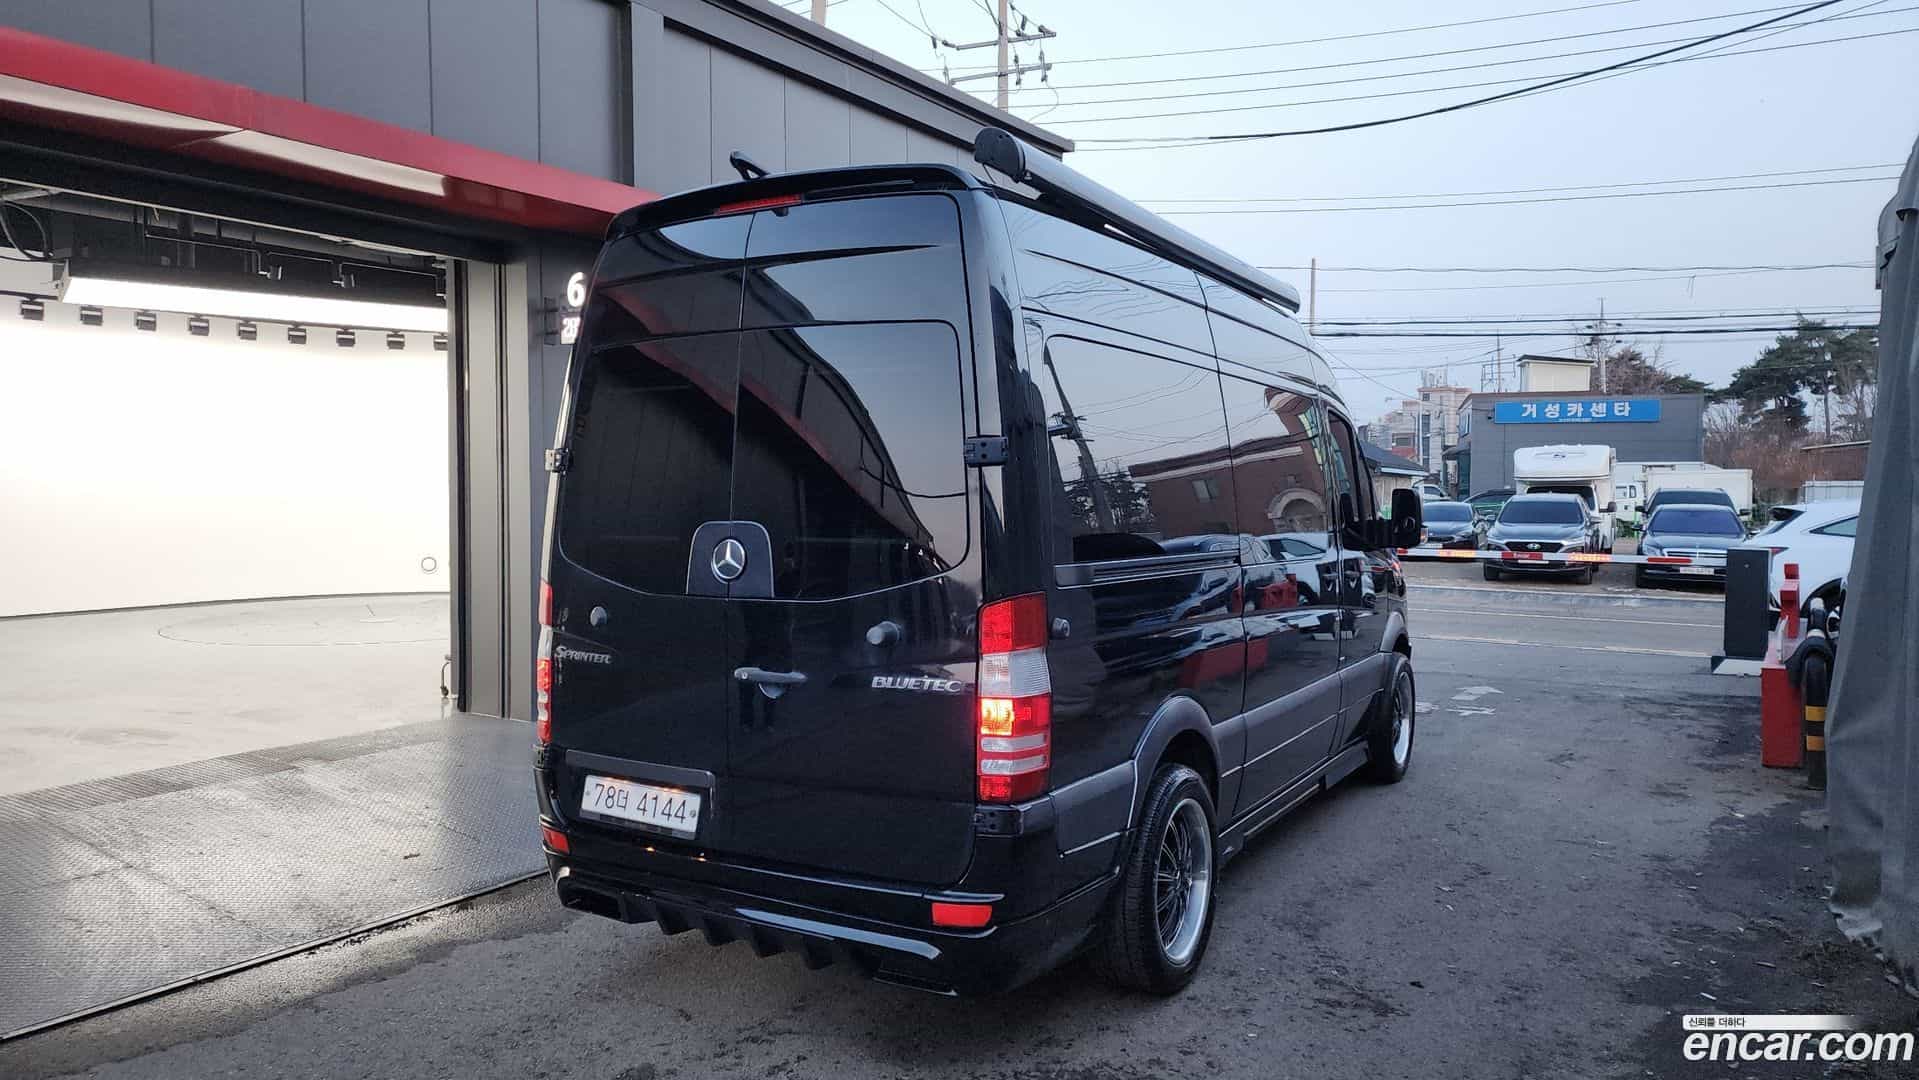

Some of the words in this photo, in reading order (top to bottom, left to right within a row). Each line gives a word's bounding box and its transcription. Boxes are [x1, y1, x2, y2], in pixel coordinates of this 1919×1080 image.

[567, 272, 587, 307] 6
[1521, 402, 1631, 418] 거성카센타
[555, 645, 611, 664] SPRINTER
[871, 675, 961, 692] BLUETEC
[594, 783, 629, 811] 78더
[636, 792, 687, 824] 4144
